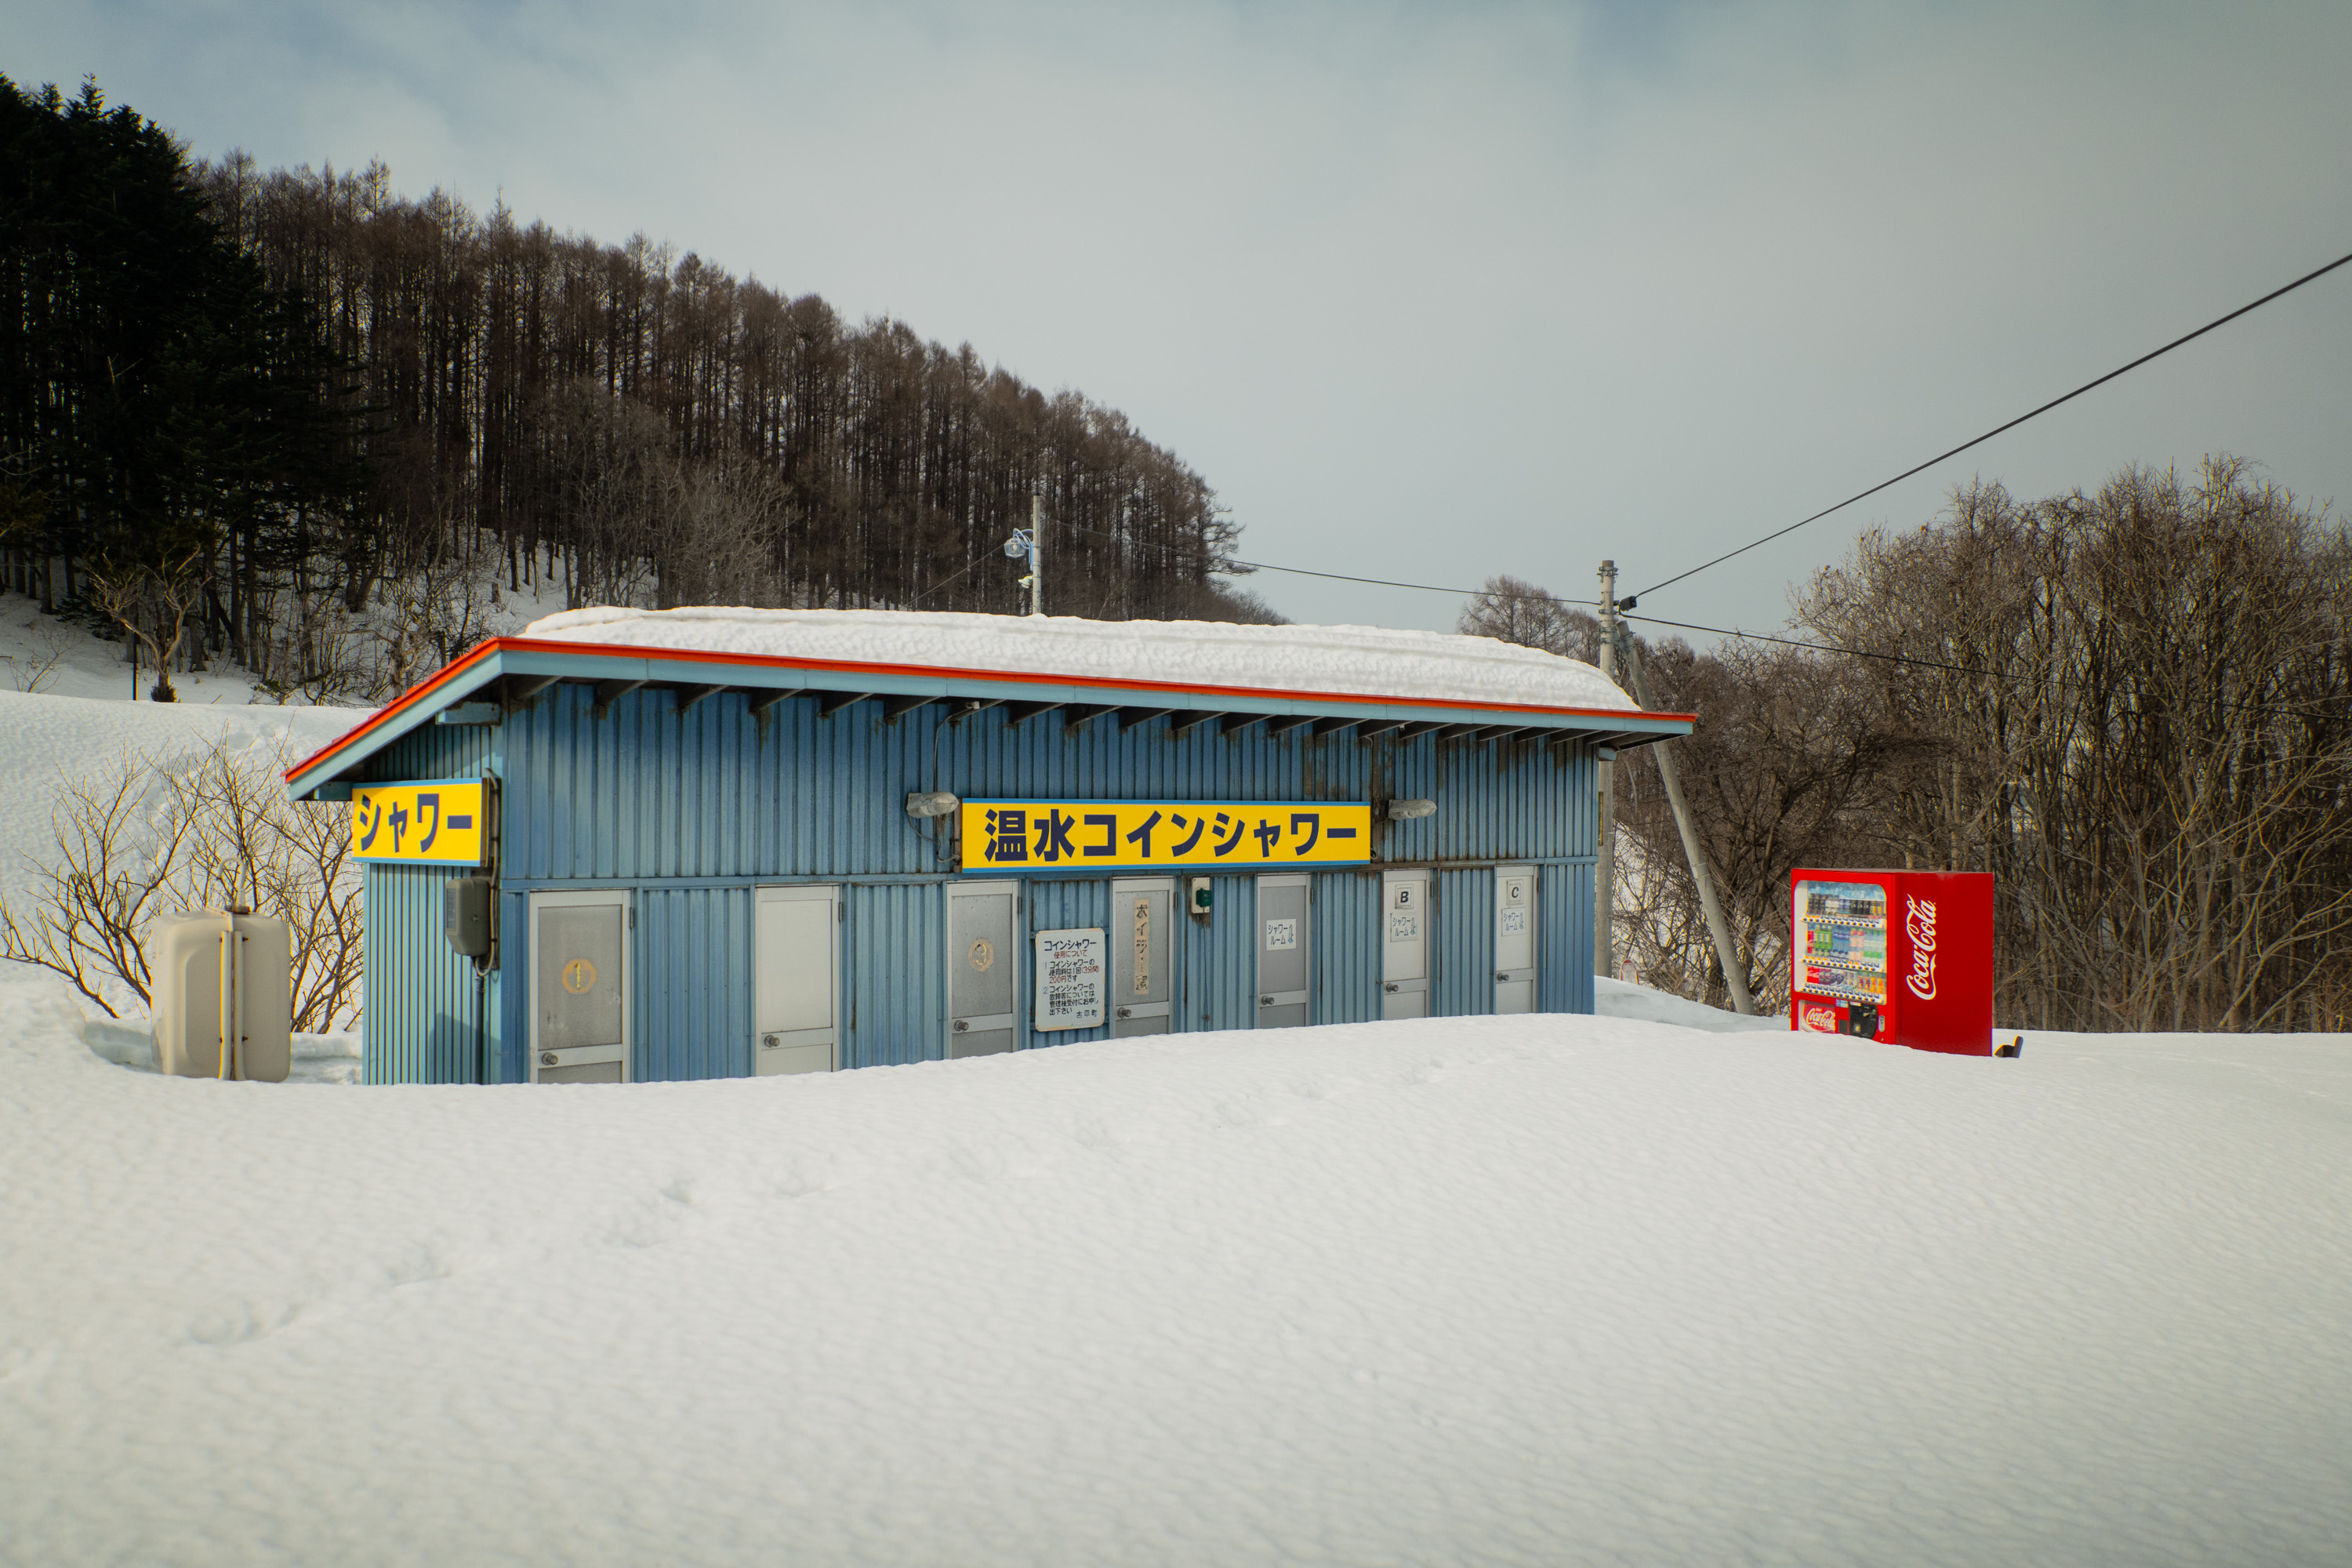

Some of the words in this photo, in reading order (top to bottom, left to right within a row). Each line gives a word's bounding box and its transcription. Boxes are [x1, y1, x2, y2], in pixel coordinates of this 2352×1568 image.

[359, 793, 472, 853] シャワー
[984, 808, 1357, 862] 温水コインシャワー
[1400, 891, 1409, 902] B
[1512, 887, 1519, 898] C
[1392, 916, 1411, 927] シャワー
[1503, 912, 1519, 922] シャワー
[1268, 924, 1288, 935] シャワー
[1395, 927, 1409, 937] ルーム
[1505, 922, 1518, 931] ルーム
[1044, 938, 1097, 952] コインシャワー
[1270, 935, 1286, 946] ルーム
[1906, 893, 1936, 1000] Coca-Cola
[1054, 949, 1087, 959] 使用について
[1049, 959, 1095, 969] コインシャワーの
[1049, 975, 1077, 984] 200円です
[1043, 986, 1048, 995] 2
[1049, 983, 1094, 993] コインシャワーの
[1049, 1007, 1073, 1016] 出下さい
